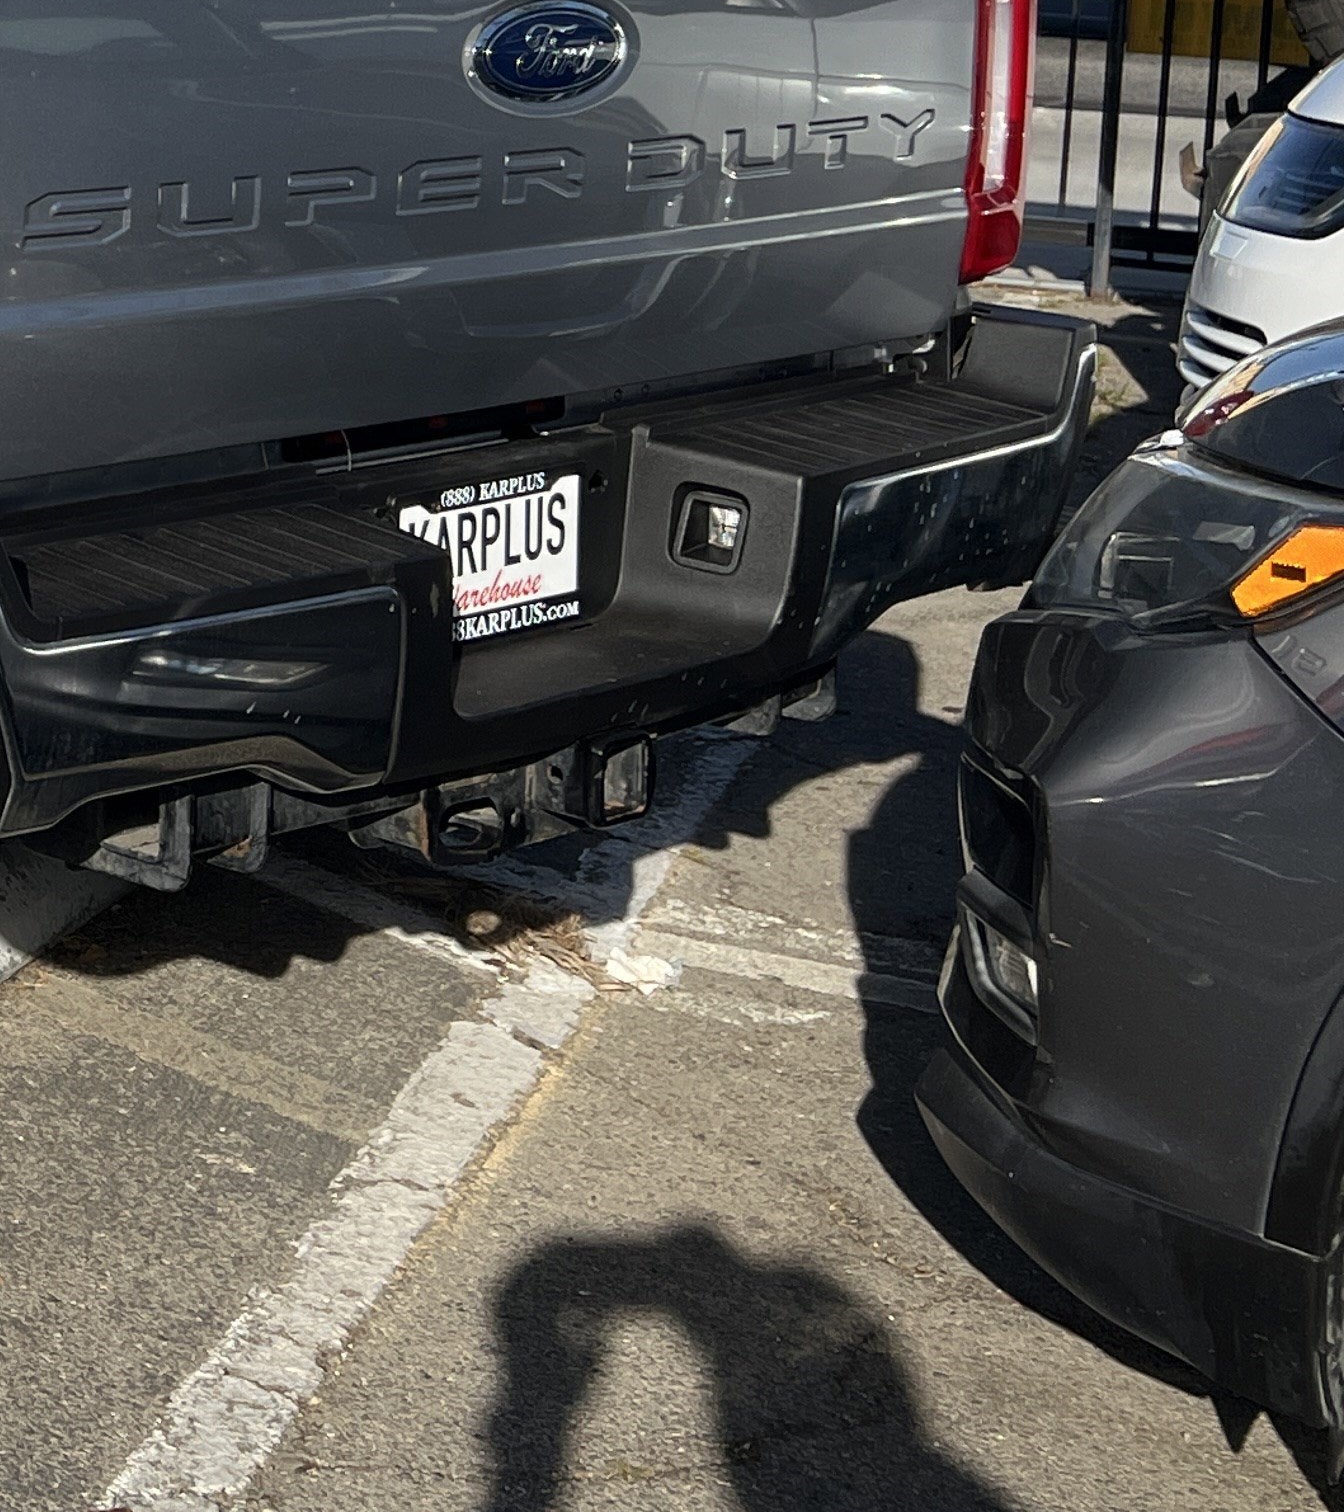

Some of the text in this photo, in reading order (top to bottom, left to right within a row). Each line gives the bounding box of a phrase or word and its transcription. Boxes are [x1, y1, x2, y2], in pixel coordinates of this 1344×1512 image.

[515, 23, 597, 78] Ford
[22, 107, 937, 252] SUPER DUTY
[440, 472, 545, 507] (888) KARPLUS
[408, 492, 567, 577] ARPLUS
[453, 569, 543, 612] arehouse
